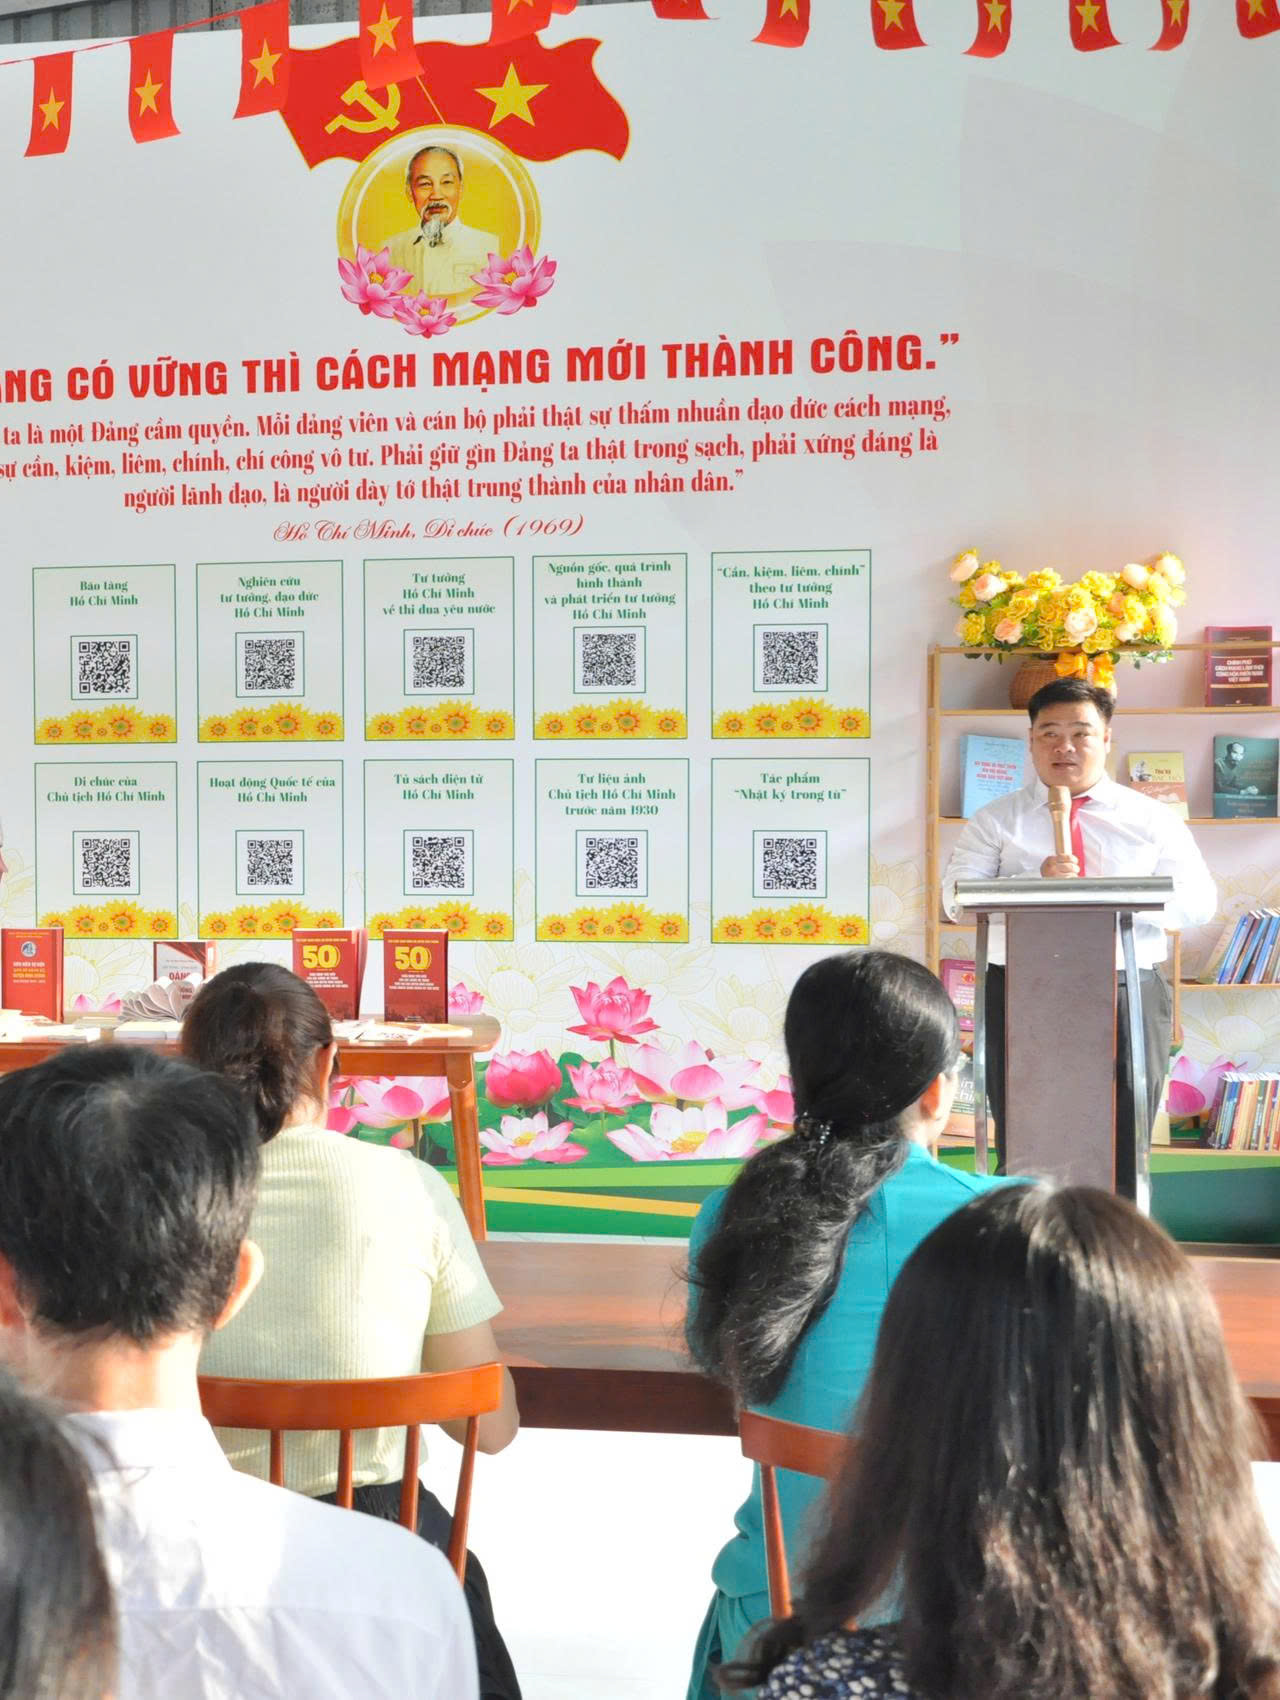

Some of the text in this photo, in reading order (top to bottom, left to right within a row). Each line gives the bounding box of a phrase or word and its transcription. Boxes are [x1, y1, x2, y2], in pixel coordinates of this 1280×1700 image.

[68, 359, 114, 400] CÓ
[128, 356, 228, 398] VỮNG
[242, 352, 300, 394] THÌ
[316, 348, 416, 391] CÁCH
[432, 348, 550, 393] MẠNG
[567, 338, 646, 382] MỚI
[661, 334, 793, 379] THÀNH
[3, 427, 20, 445] ta
[28, 423, 43, 444] là
[50, 424, 83, 446] một
[92, 421, 139, 446] Đảng
[144, 417, 182, 440] cầm
[188, 415, 250, 444] quyền.
[257, 412, 290, 435] Mỗi
[296, 412, 342, 440] đảng
[349, 411, 388, 432] viên
[395, 412, 416, 431] và
[423, 411, 456, 430] cán
[464, 407, 486, 432] bộ
[494, 406, 535, 434] phải
[542, 404, 581, 430] thật
[590, 408, 612, 429] sự
[619, 400, 670, 424] thấm
[678, 398, 740, 422] nhuần
[747, 398, 784, 424] đạo
[790, 396, 827, 419] đức
[834, 394, 880, 418] cách
[888, 396, 951, 422] mạng,
[22, 455, 59, 477] cần,
[66, 455, 115, 479] kiệm,
[122, 452, 166, 474] liêm,
[172, 450, 230, 472] chính,
[236, 448, 264, 470] chí
[271, 450, 314, 474] công
[321, 448, 342, 467] vô
[349, 448, 374, 466] tư.
[382, 444, 422, 465] Phải
[430, 443, 460, 470] giữ
[466, 444, 495, 470] gìn
[504, 441, 554, 467] Đảng
[560, 442, 579, 460] ta
[587, 438, 625, 464] thật
[634, 439, 688, 464] trong
[695, 434, 744, 460] sạch,
[752, 432, 796, 462] phải
[804, 434, 856, 460] xứng
[862, 430, 912, 458] đáng
[920, 428, 938, 450] là
[124, 485, 174, 513] người
[182, 483, 222, 505] lãnh
[228, 482, 266, 508] đạo,
[274, 481, 290, 502] là
[298, 480, 349, 508] người
[356, 477, 389, 507] đày
[397, 480, 415, 499] tớ
[422, 476, 460, 502] thật
[468, 478, 522, 503] trung
[529, 472, 586, 496] thành
[593, 473, 627, 494] của
[634, 471, 684, 493] nhân
[273, 519, 310, 542] Hồ
[314, 519, 351, 541] Chí
[423, 518, 455, 538] Di
[456, 521, 494, 537] chúc
[503, 512, 584, 538] (1969)
[111, 594, 138, 605] Minh
[798, 598, 828, 608] Minh
[303, 945, 339, 969] 50
[395, 946, 431, 970] 50
